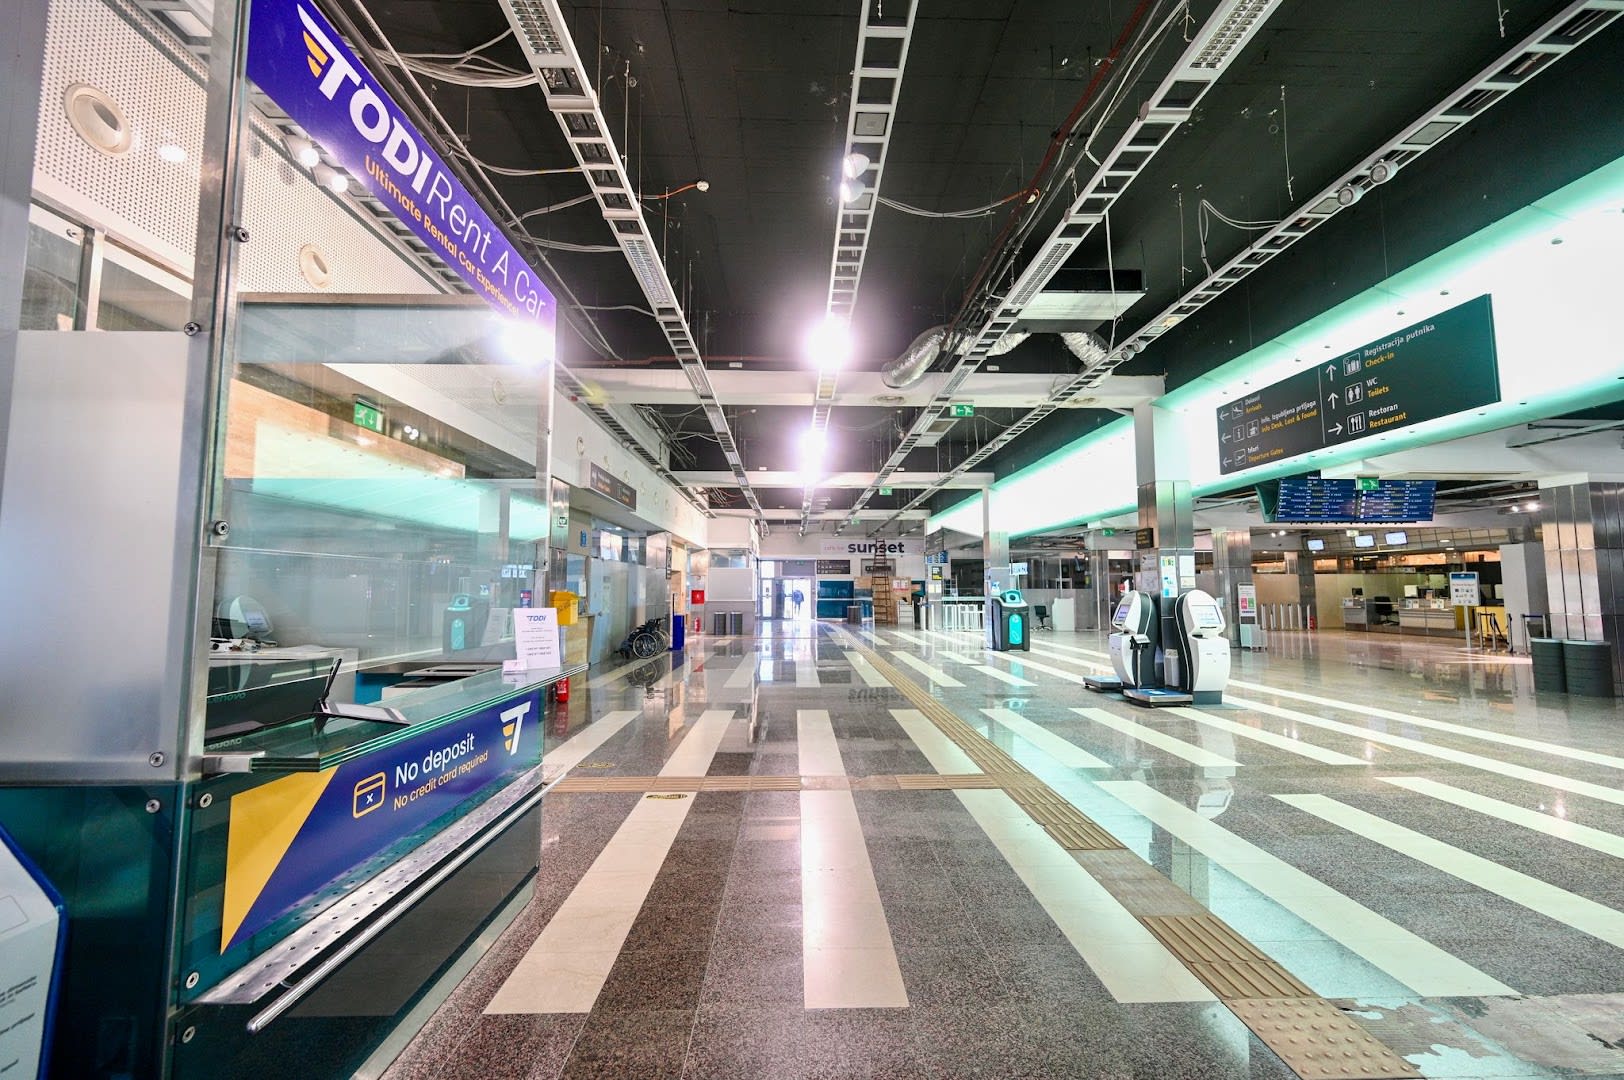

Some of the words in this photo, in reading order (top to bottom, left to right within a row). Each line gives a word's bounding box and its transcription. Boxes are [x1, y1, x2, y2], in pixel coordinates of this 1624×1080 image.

[297, 4, 434, 195] TODI
[426, 171, 492, 264] Rent
[492, 250, 509, 286] A
[514, 270, 546, 320] Car
[365, 154, 422, 222] Ultimate
[423, 215, 457, 258] Rental
[458, 251, 476, 275] Car
[1364, 336, 1405, 357] Registracija
[1405, 324, 1436, 342] putnika
[1364, 351, 1395, 368] Check-in
[1366, 376, 1378, 387] WC
[1367, 385, 1390, 398] Toilets
[1368, 403, 1399, 417] Restoran
[1284, 416, 1295, 426] Lost
[1369, 411, 1408, 428] Restaurant
[847, 542, 905, 553] sunset
[395, 762, 419, 788] No
[422, 732, 475, 772] deposit
[393, 795, 408, 811] No
[409, 777, 437, 801] credit
[438, 765, 457, 786] card
[458, 749, 489, 775] required
